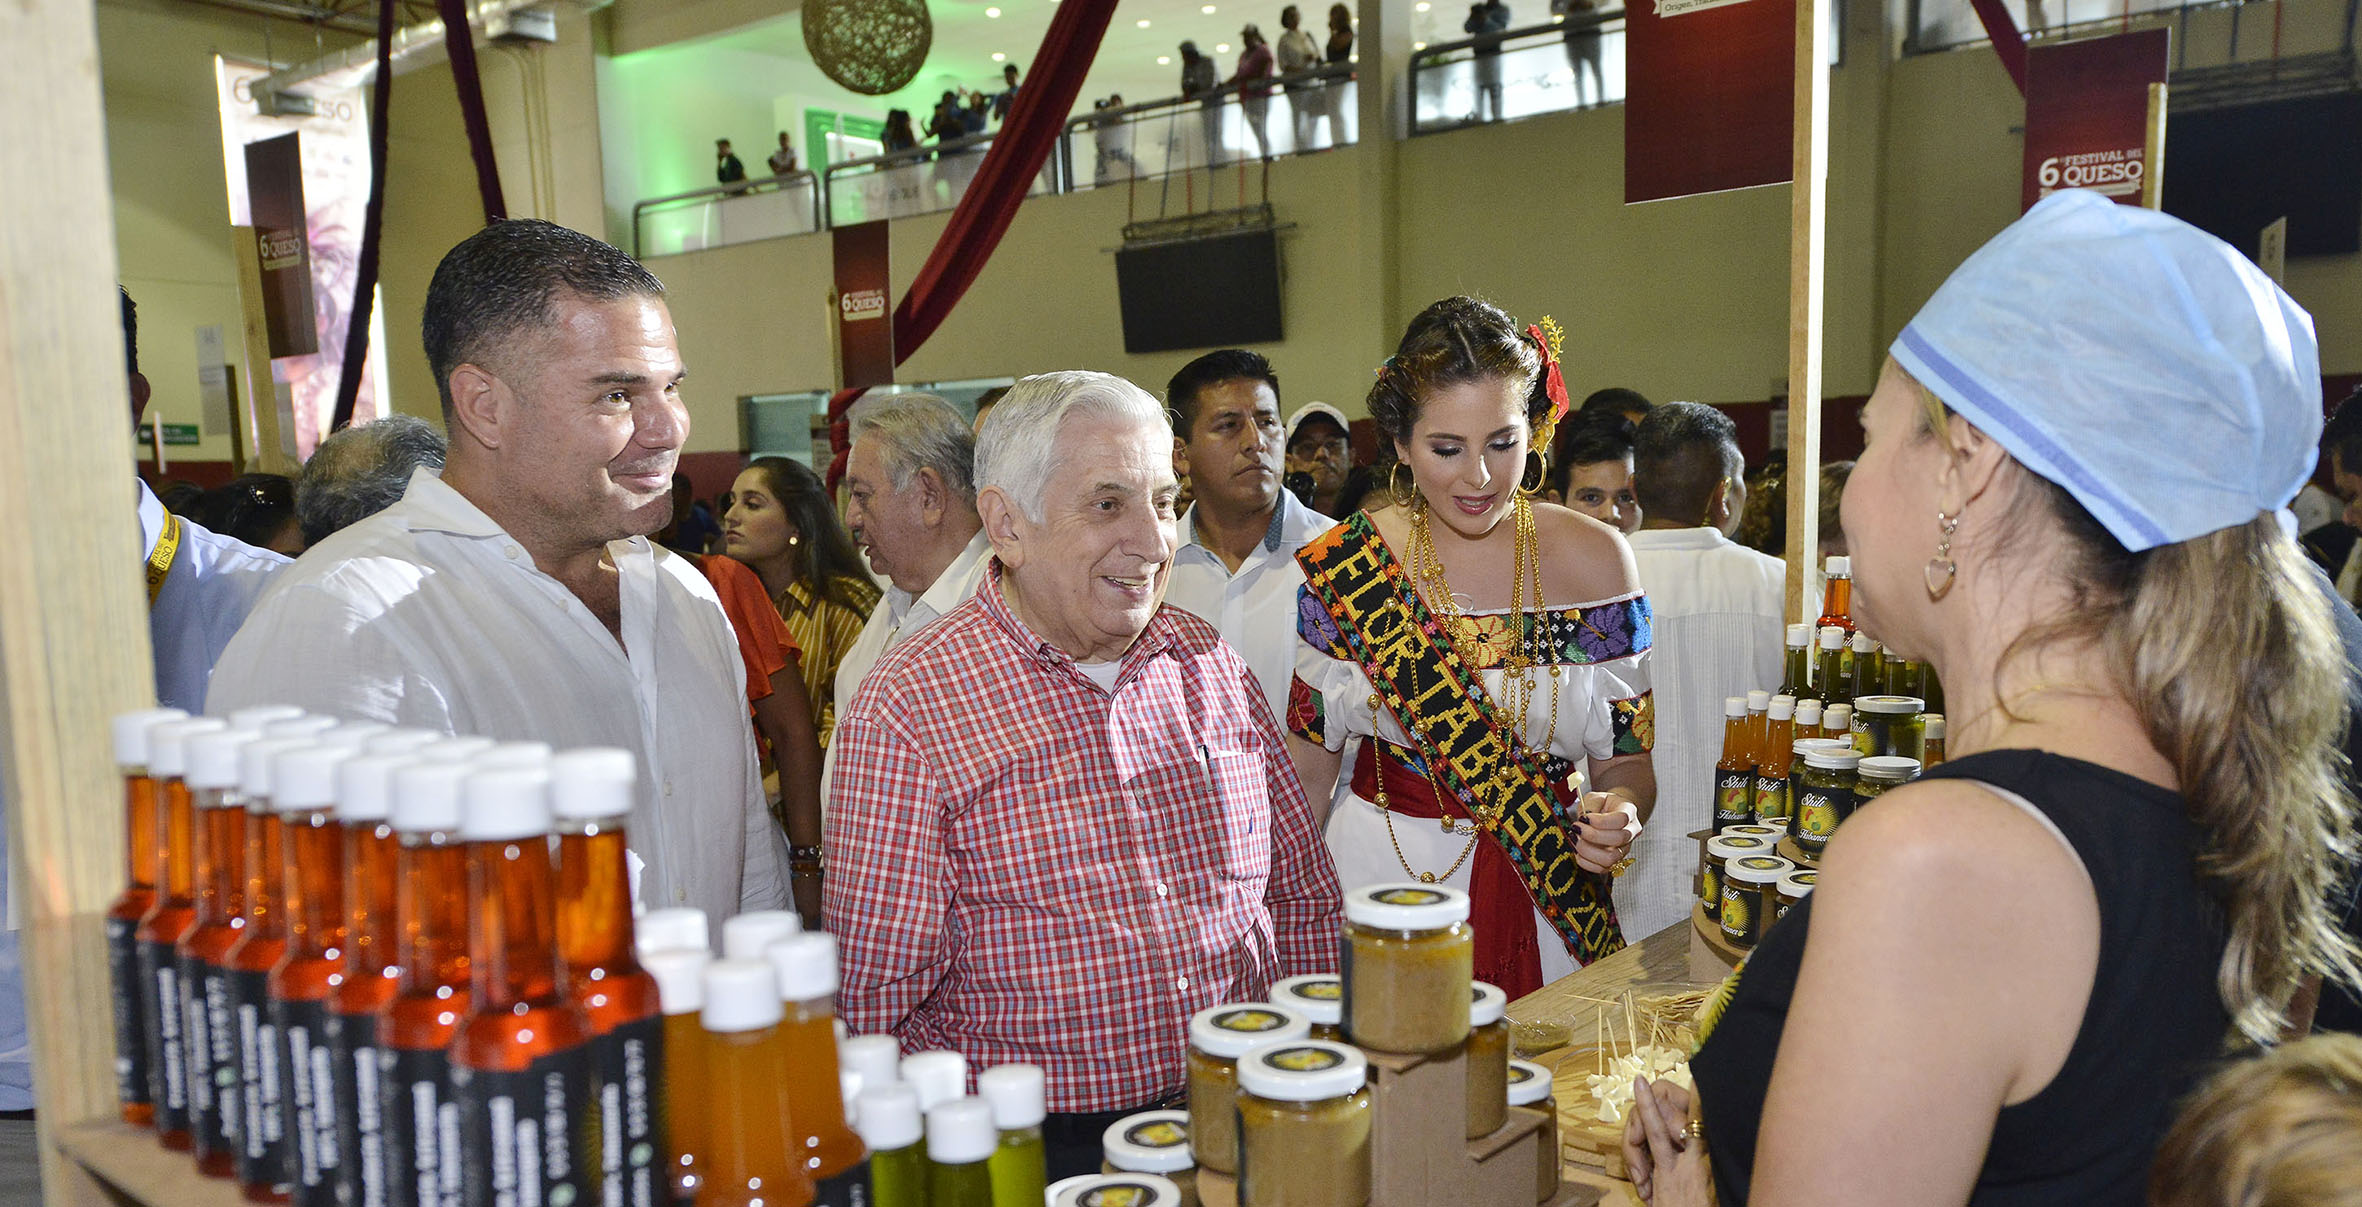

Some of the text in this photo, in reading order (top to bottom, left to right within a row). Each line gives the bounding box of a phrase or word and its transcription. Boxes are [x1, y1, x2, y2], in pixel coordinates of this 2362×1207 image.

[2064, 150, 2124, 166] FESTIVAL
[2039, 158, 2060, 187] 6
[2063, 161, 2143, 186] QUESO
[270, 237, 301, 258] QUESO
[842, 293, 851, 311] 6
[852, 295, 885, 311] QUESO
[153, 545, 172, 577] QUESO
[1325, 545, 1430, 681] FLOR
[1406, 656, 1580, 898] TABASCO
[1720, 775, 1749, 788] Shili
[1755, 777, 1780, 791] Shili
[1801, 793, 1828, 807] Shili
[1722, 885, 1740, 900] Shili
